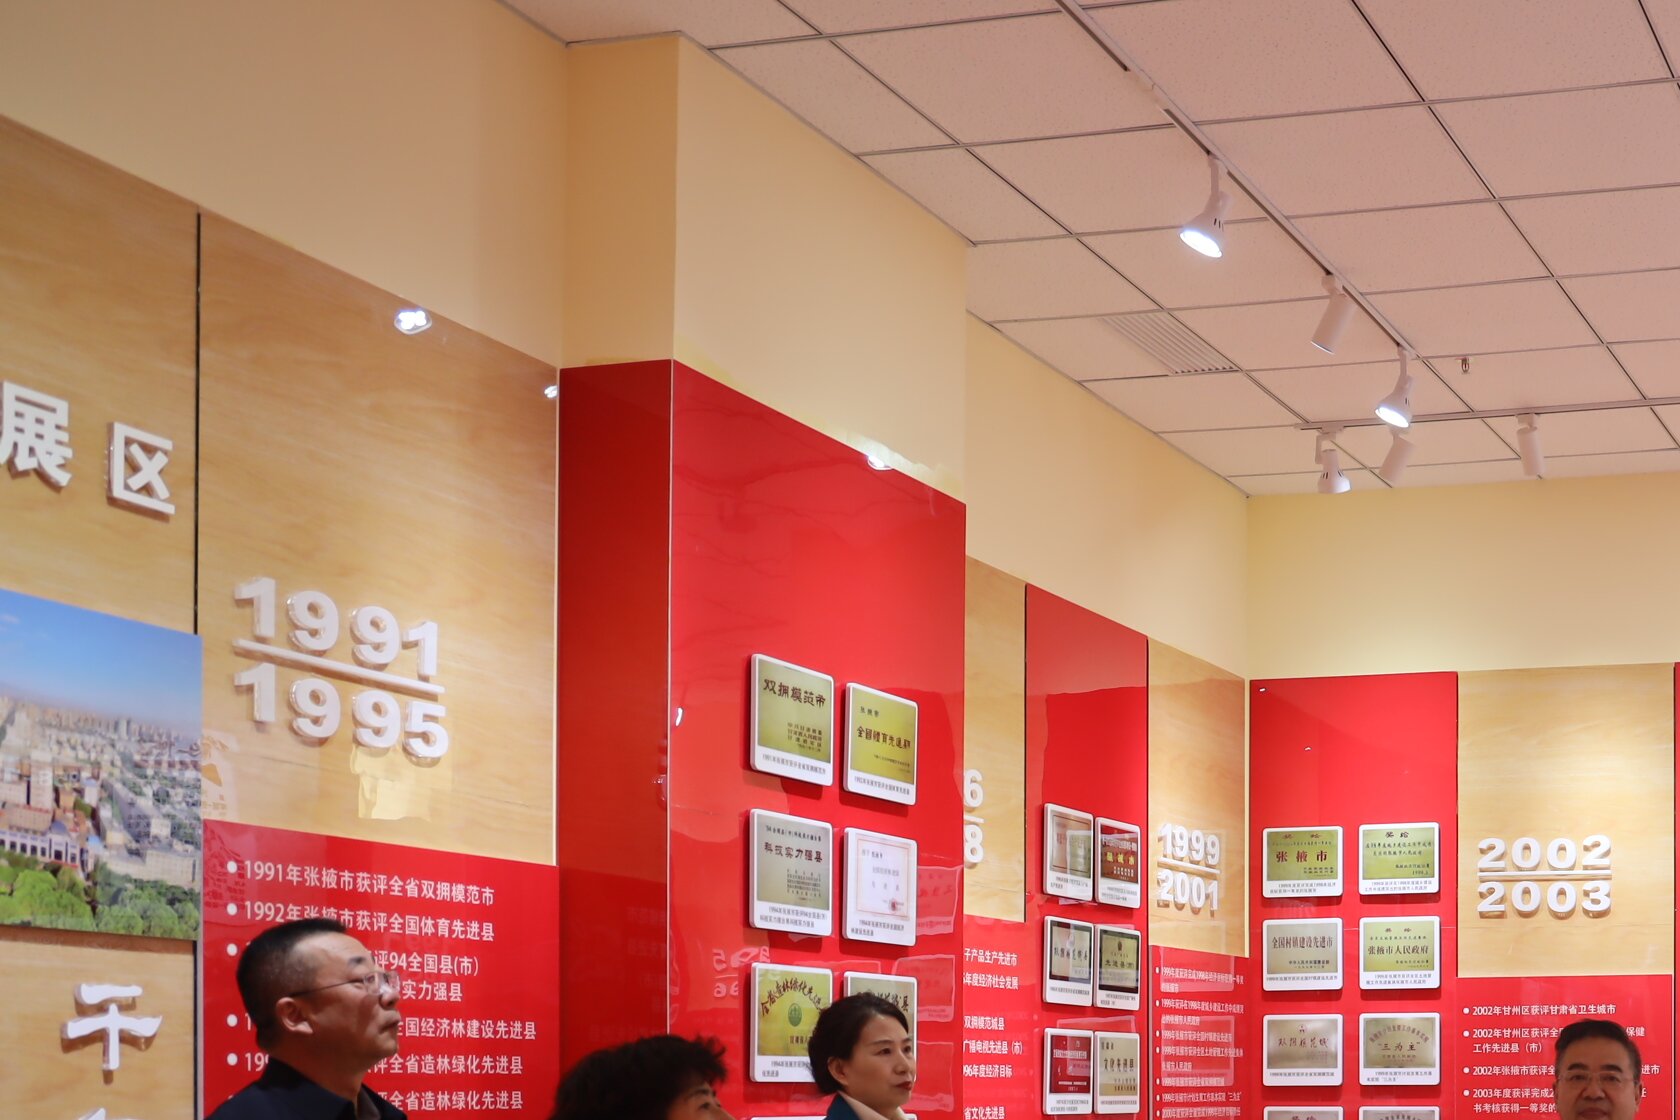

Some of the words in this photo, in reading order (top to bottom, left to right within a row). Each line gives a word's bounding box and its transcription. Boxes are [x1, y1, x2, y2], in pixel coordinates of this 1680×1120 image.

[0, 380, 175, 516] 展区
[234, 577, 438, 679] 1991
[234, 661, 449, 762] 1995
[1159, 823, 1220, 867] 1999
[1276, 851, 1327, 863] 张掖市
[1477, 834, 1612, 869] 2002
[244, 860, 495, 906] 1991年张掖市获评全省双拥模范市
[1158, 870, 1219, 911] 2001
[1477, 881, 1612, 913] 2003
[1367, 945, 1429, 956] 张掖市人民政府
[1472, 1004, 1617, 1017] 2002年甘州区获评甘肃省卫生城市
